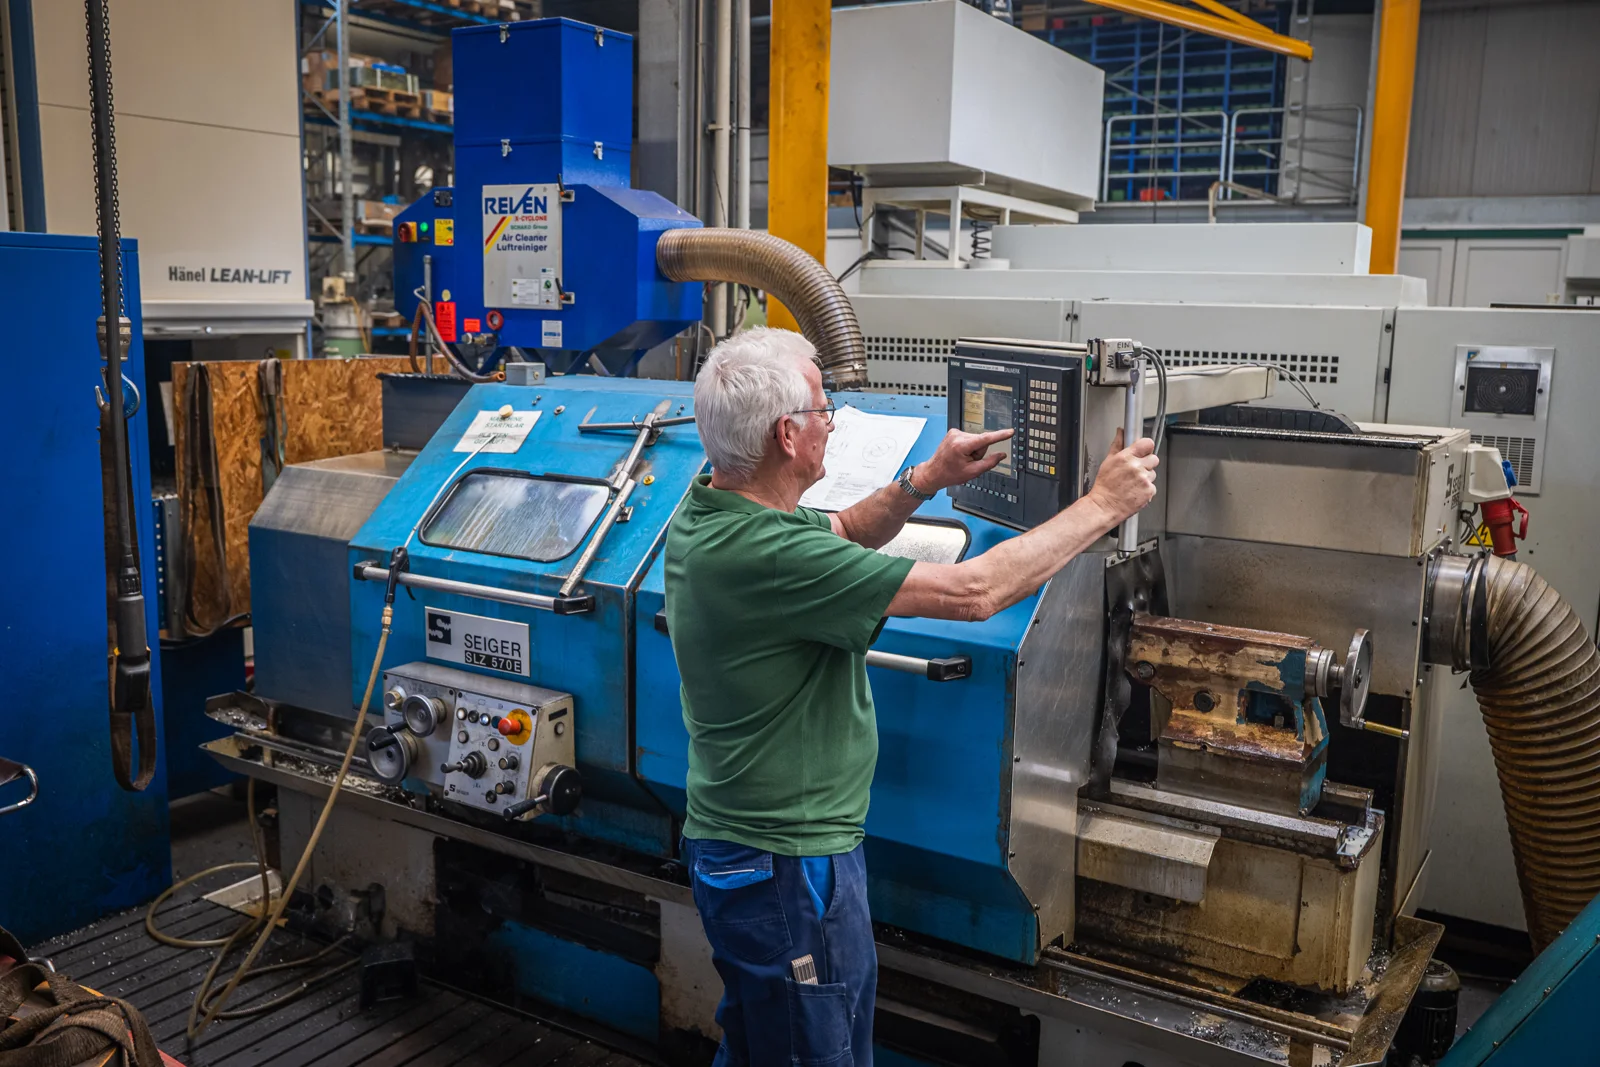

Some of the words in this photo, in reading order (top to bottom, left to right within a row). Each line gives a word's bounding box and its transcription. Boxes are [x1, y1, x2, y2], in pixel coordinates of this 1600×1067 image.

[484, 187, 547, 214] REVEN
[515, 233, 547, 242] Cleaner
[496, 243, 547, 253] Luftreiniger
[168, 266, 206, 282] Hänel
[210, 268, 291, 284] LEAN-LIFT
[1117, 341, 1130, 349] EIN
[1107, 354, 1115, 369] AUS
[464, 633, 521, 658] SEIGER
[465, 651, 487, 666] SLZ
[491, 657, 521, 673] 570E
